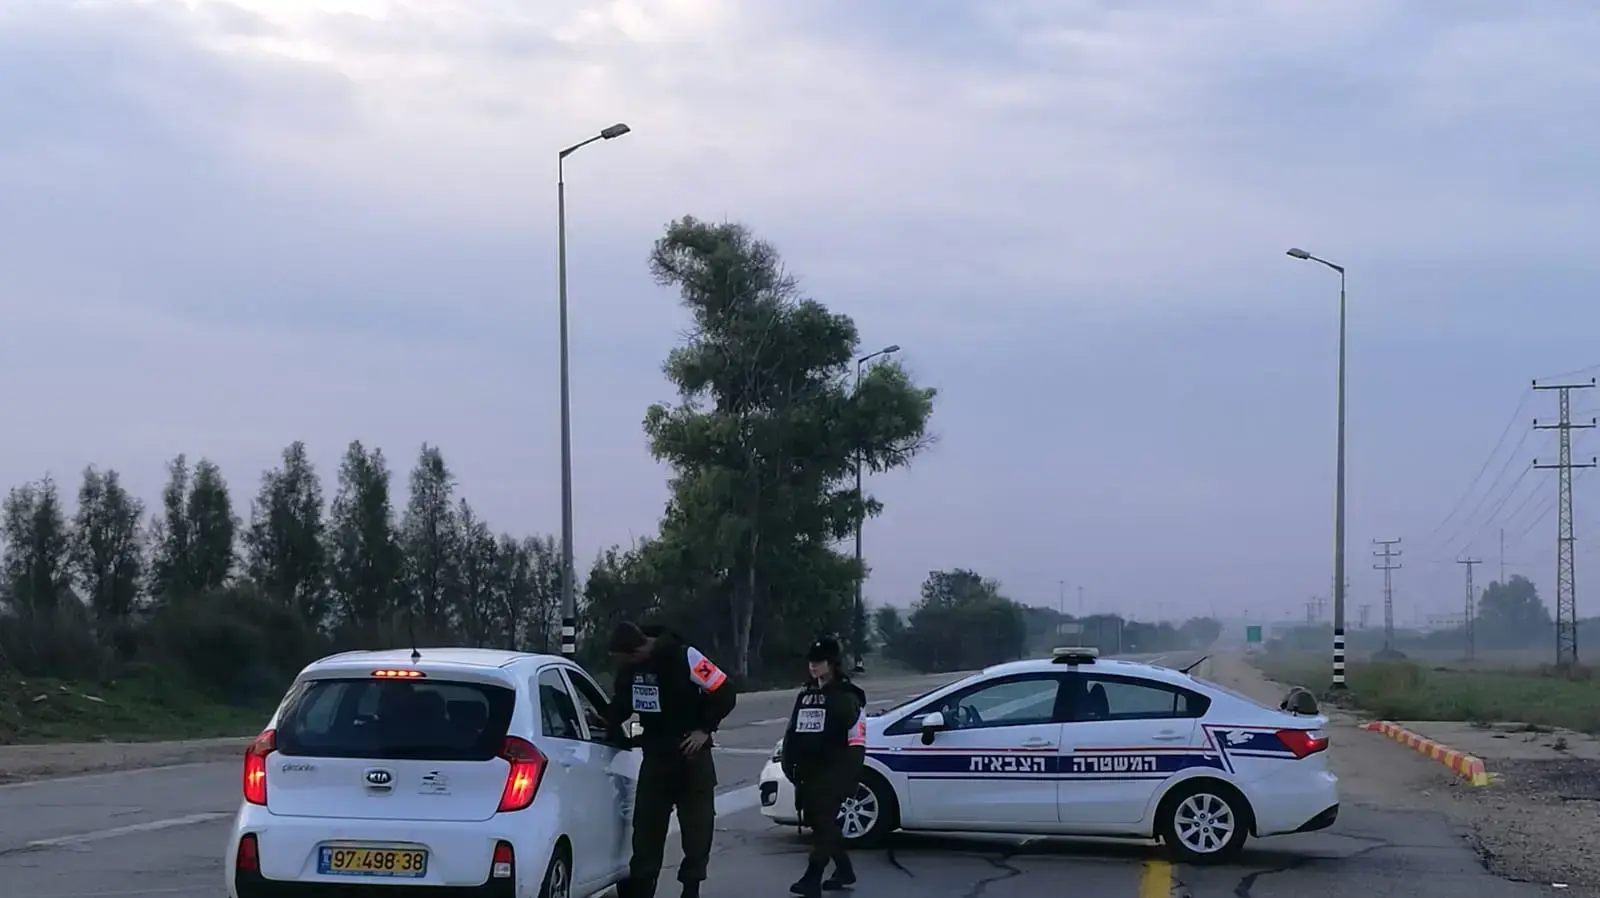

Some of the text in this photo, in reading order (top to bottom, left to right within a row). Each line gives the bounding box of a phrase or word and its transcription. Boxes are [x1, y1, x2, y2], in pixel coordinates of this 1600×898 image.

[969, 756, 1157, 772] המשטרה הצבאית
[369, 772, 389, 782] KIA
